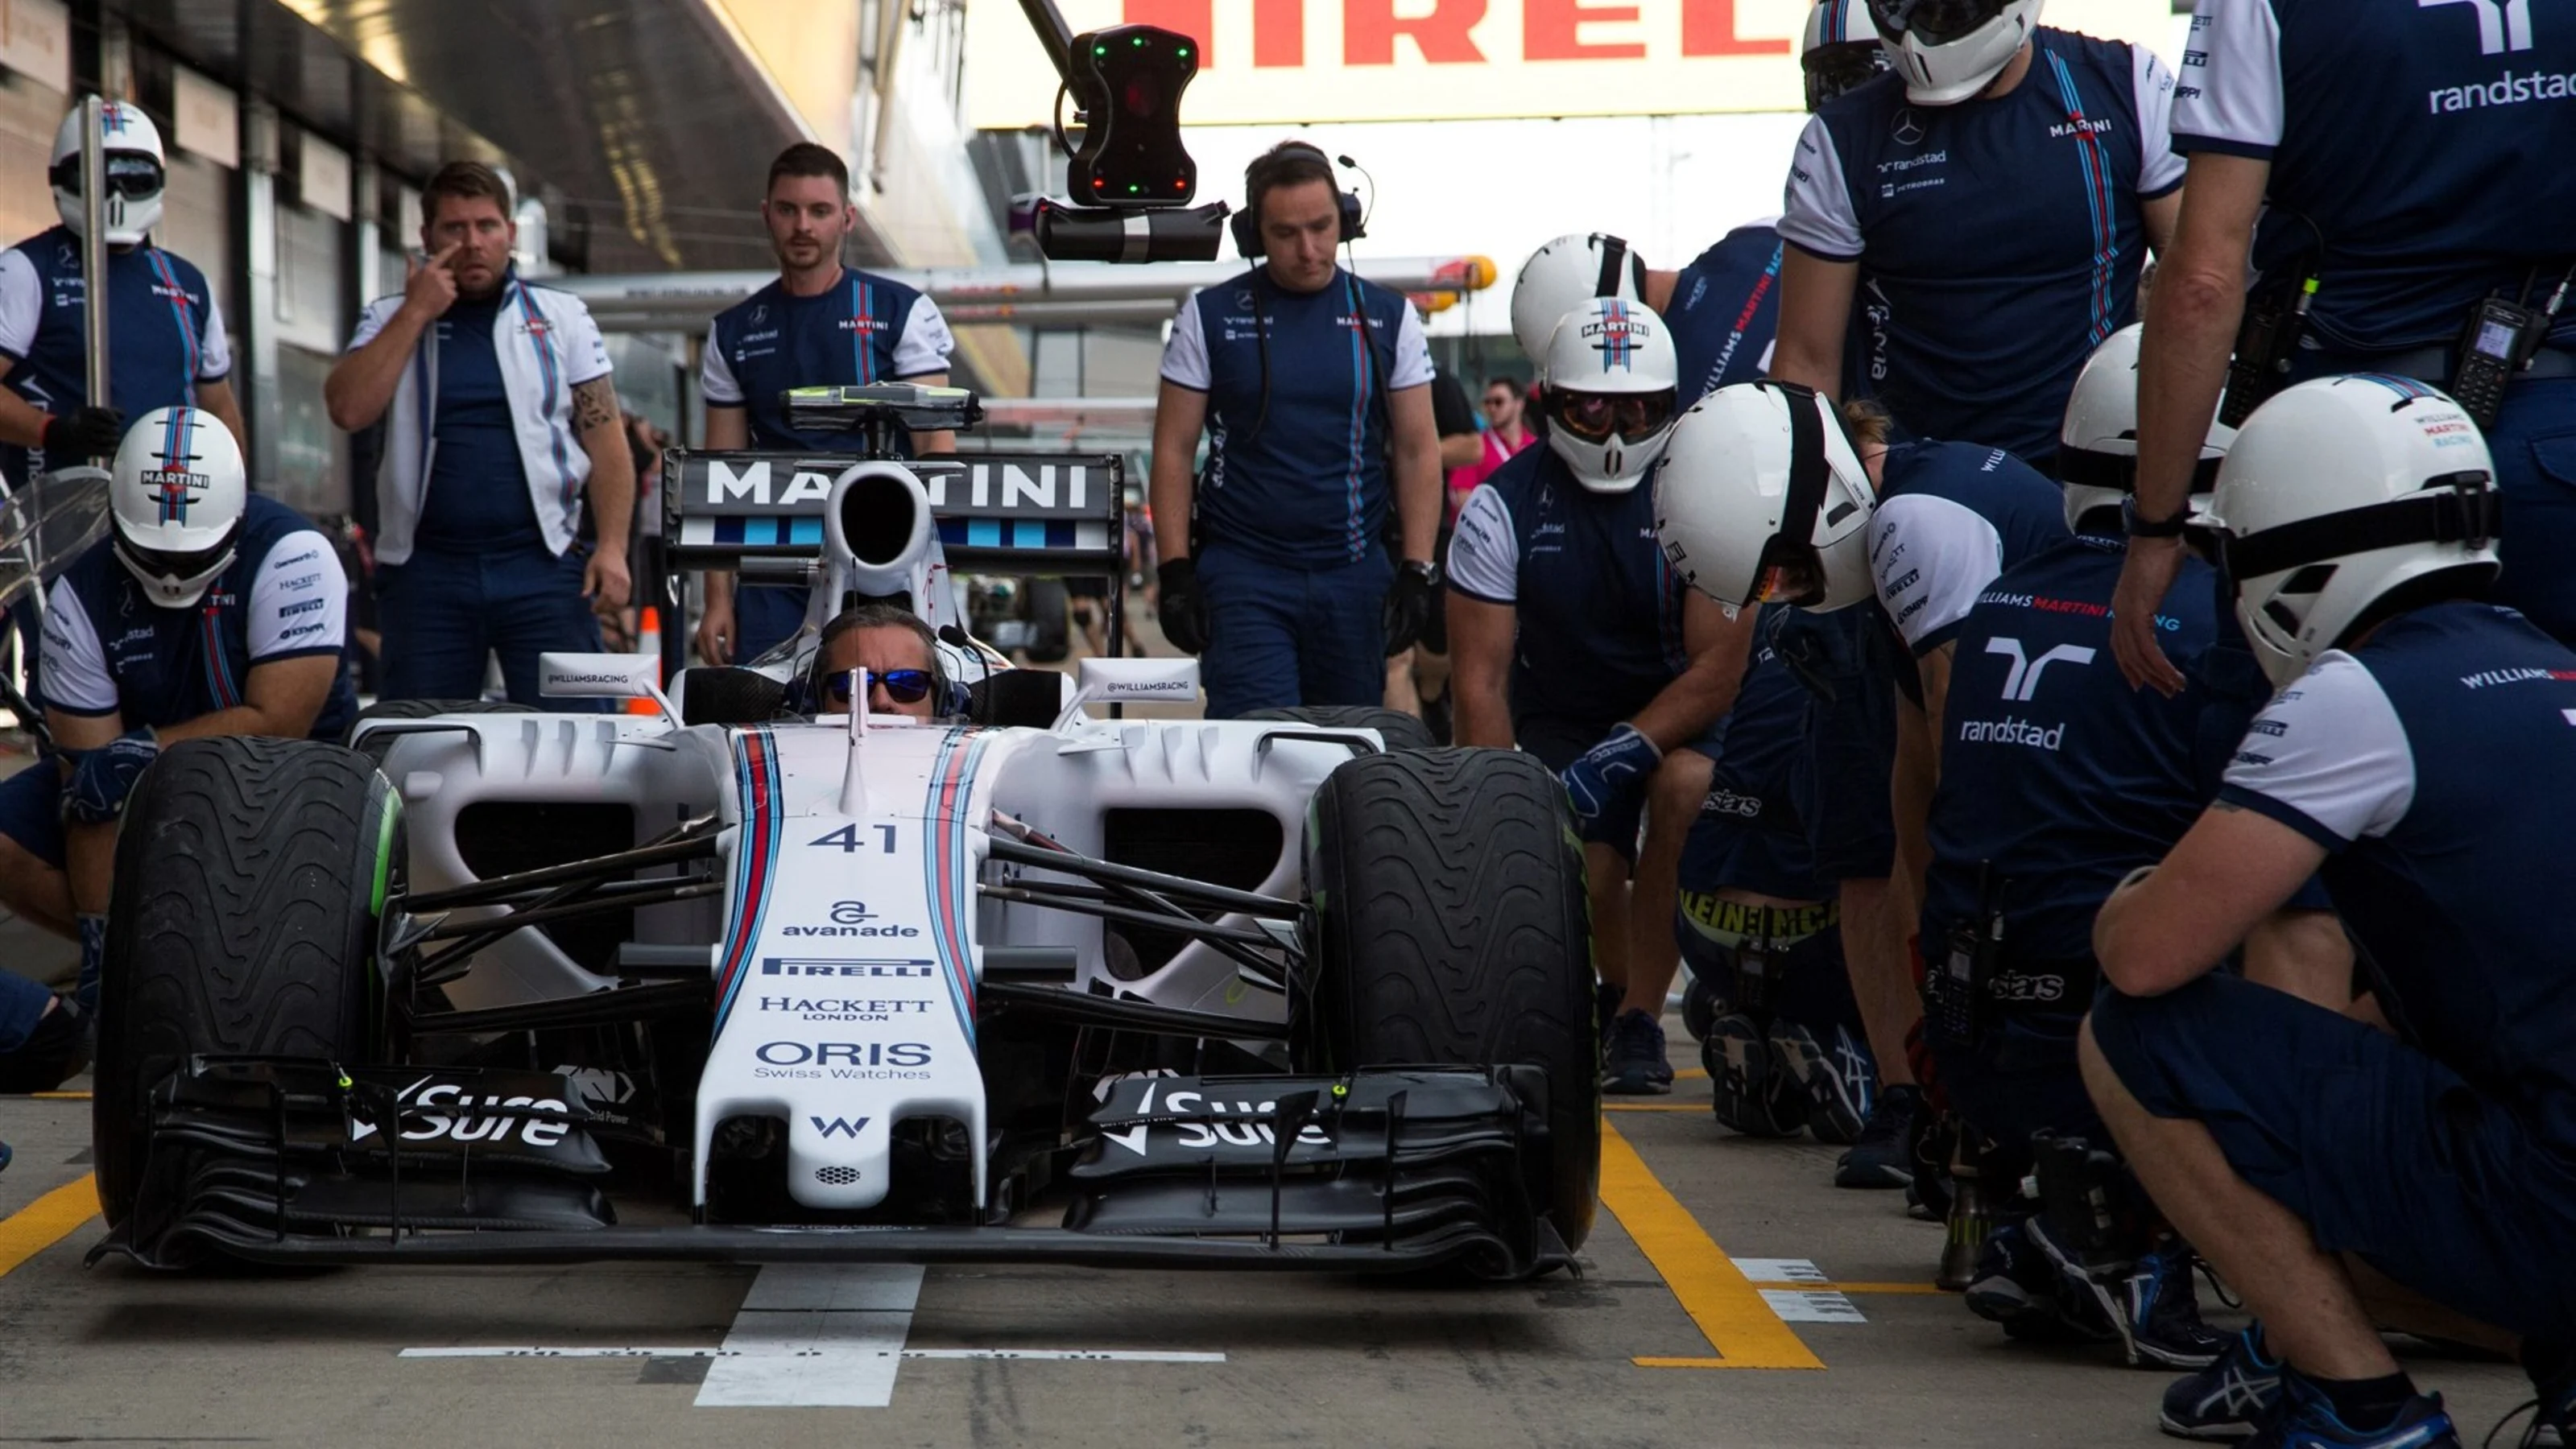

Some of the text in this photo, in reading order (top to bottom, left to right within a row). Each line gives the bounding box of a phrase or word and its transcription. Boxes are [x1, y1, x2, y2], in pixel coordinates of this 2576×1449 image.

[1894, 150, 1946, 171] randstad
[1735, 274, 1774, 332] MARTINI
[839, 320, 888, 331] MARTINI
[1584, 322, 1649, 336] MARTINI
[143, 471, 209, 487] MARTINI
[707, 460, 1086, 509] MATINI
[2031, 597, 2107, 617] MARTINI
[548, 675, 629, 685] @WILLIAMSRACING
[1107, 681, 1189, 693] @WILLIAMSRACING
[1960, 715, 2065, 750] randstad
[807, 824, 897, 853] 41
[782, 925, 920, 937] avanade
[762, 958, 935, 976] PIRELLI
[759, 997, 934, 1013] HACKETT
[803, 1013, 889, 1022] LONDON
[755, 1042, 932, 1067] ORIS
[754, 1067, 932, 1080] Swiss Watches
[399, 1084, 570, 1146] Sure
